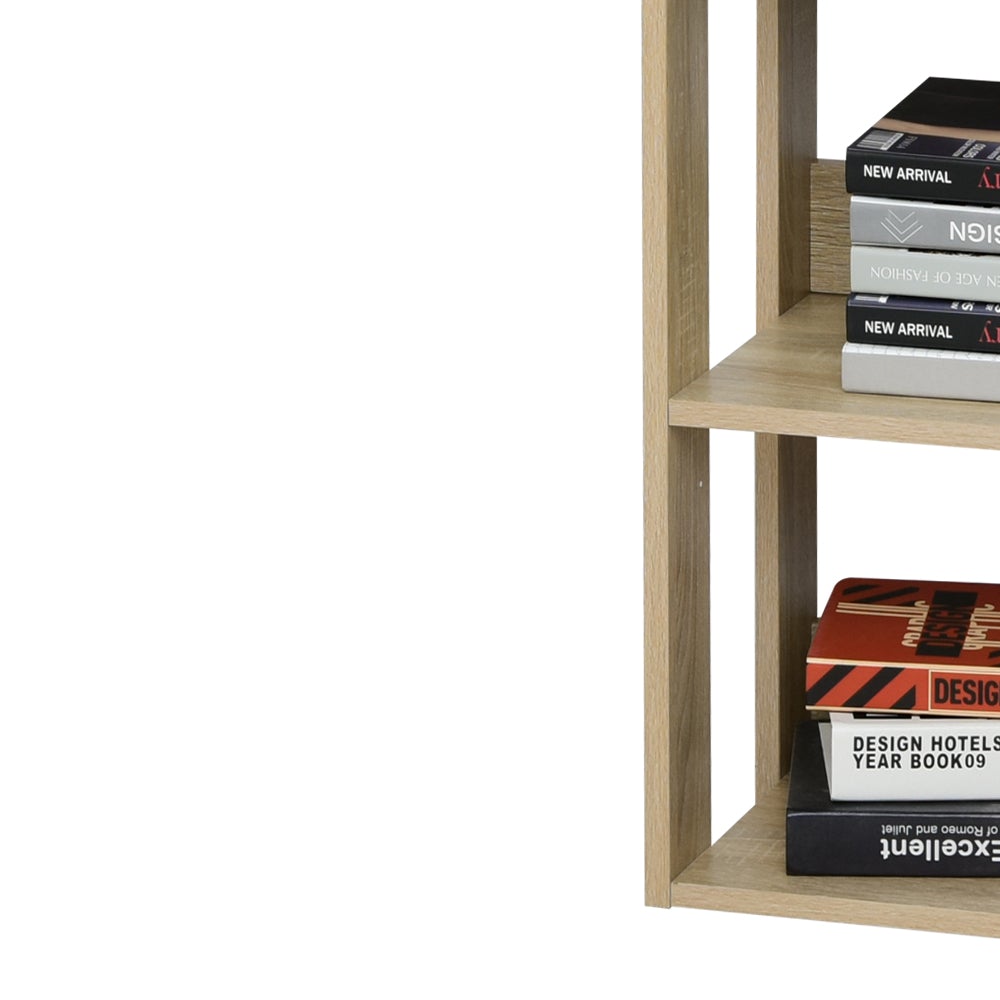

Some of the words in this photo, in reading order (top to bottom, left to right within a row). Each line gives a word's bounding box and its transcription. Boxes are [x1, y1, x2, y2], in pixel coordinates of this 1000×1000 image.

[863, 164, 894, 179] NEW
[897, 166, 952, 184] ARRIVAL
[870, 266, 928, 281] FASHION
[933, 270, 951, 283] OF
[956, 272, 983, 286] AGE
[864, 320, 895, 334] NEW
[898, 322, 953, 339] ARRIVAL
[920, 604, 973, 650] DESIGN
[853, 736, 923, 752] DESIGN
[853, 753, 901, 769] YEAR
[910, 753, 986, 769] BOOK09
[881, 824, 913, 834] Juliet
[916, 825, 938, 835] and
[941, 825, 984, 836] Romeo
[986, 824, 998, 835] of
